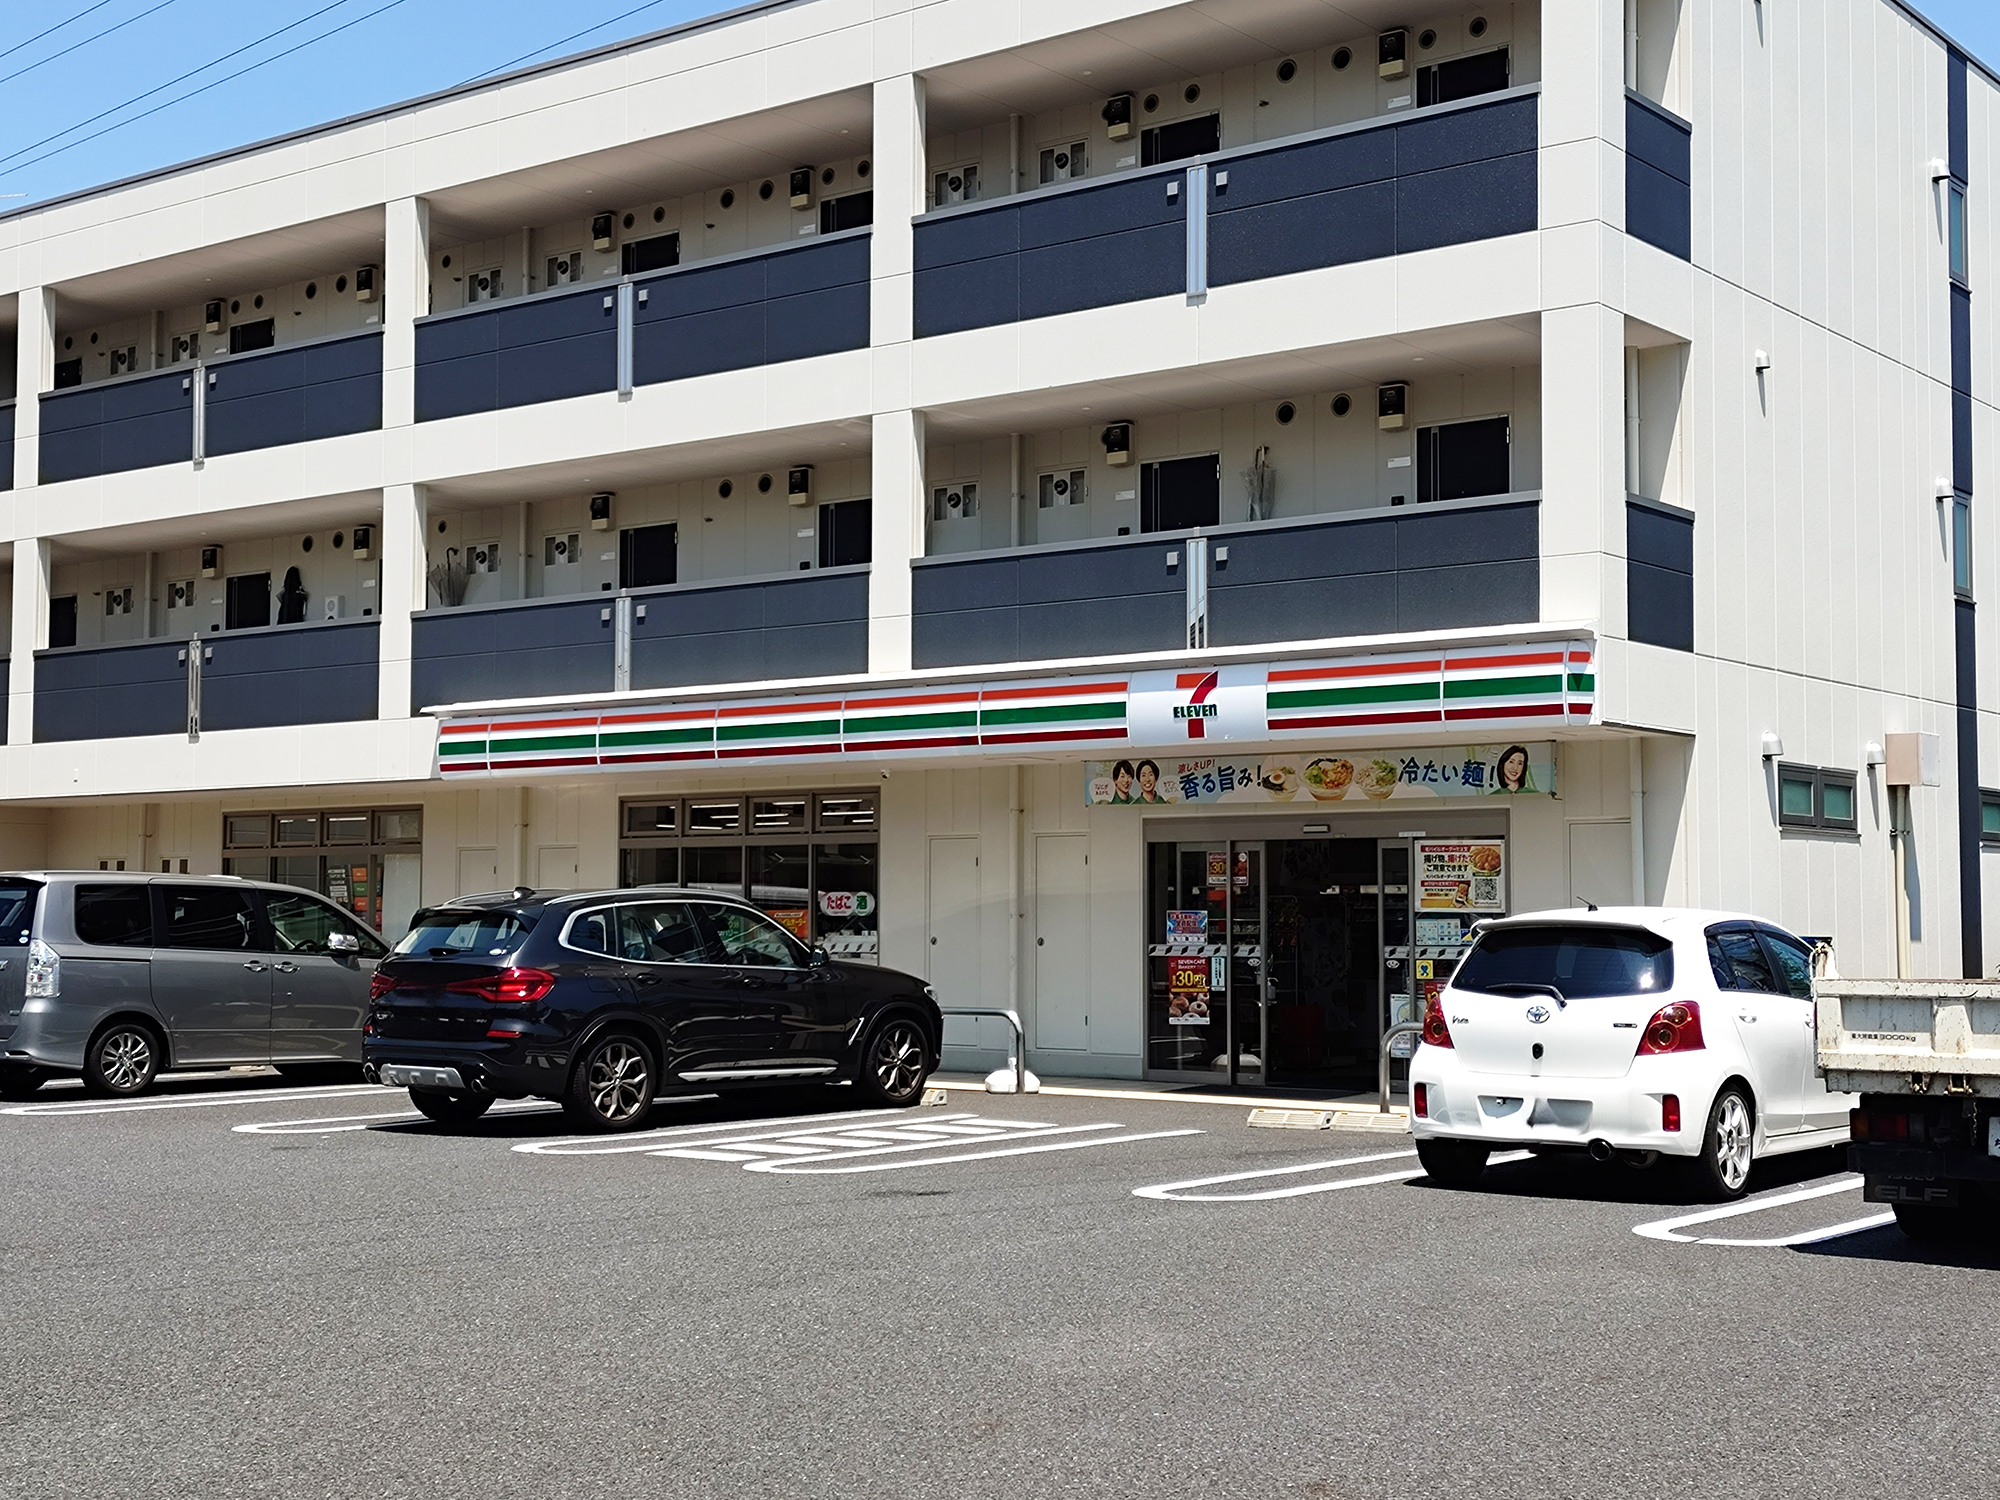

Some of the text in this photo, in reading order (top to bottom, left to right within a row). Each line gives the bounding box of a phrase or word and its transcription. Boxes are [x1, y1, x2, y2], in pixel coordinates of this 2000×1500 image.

[1176, 670, 1218, 739] 7
[1179, 765, 1263, 800] 香る旨み!
[1398, 756, 1496, 788] 冷たい麺!
[827, 895, 852, 910] たばこ
[856, 895, 868, 910] 酒
[1874, 1184, 1949, 1202] ELF
